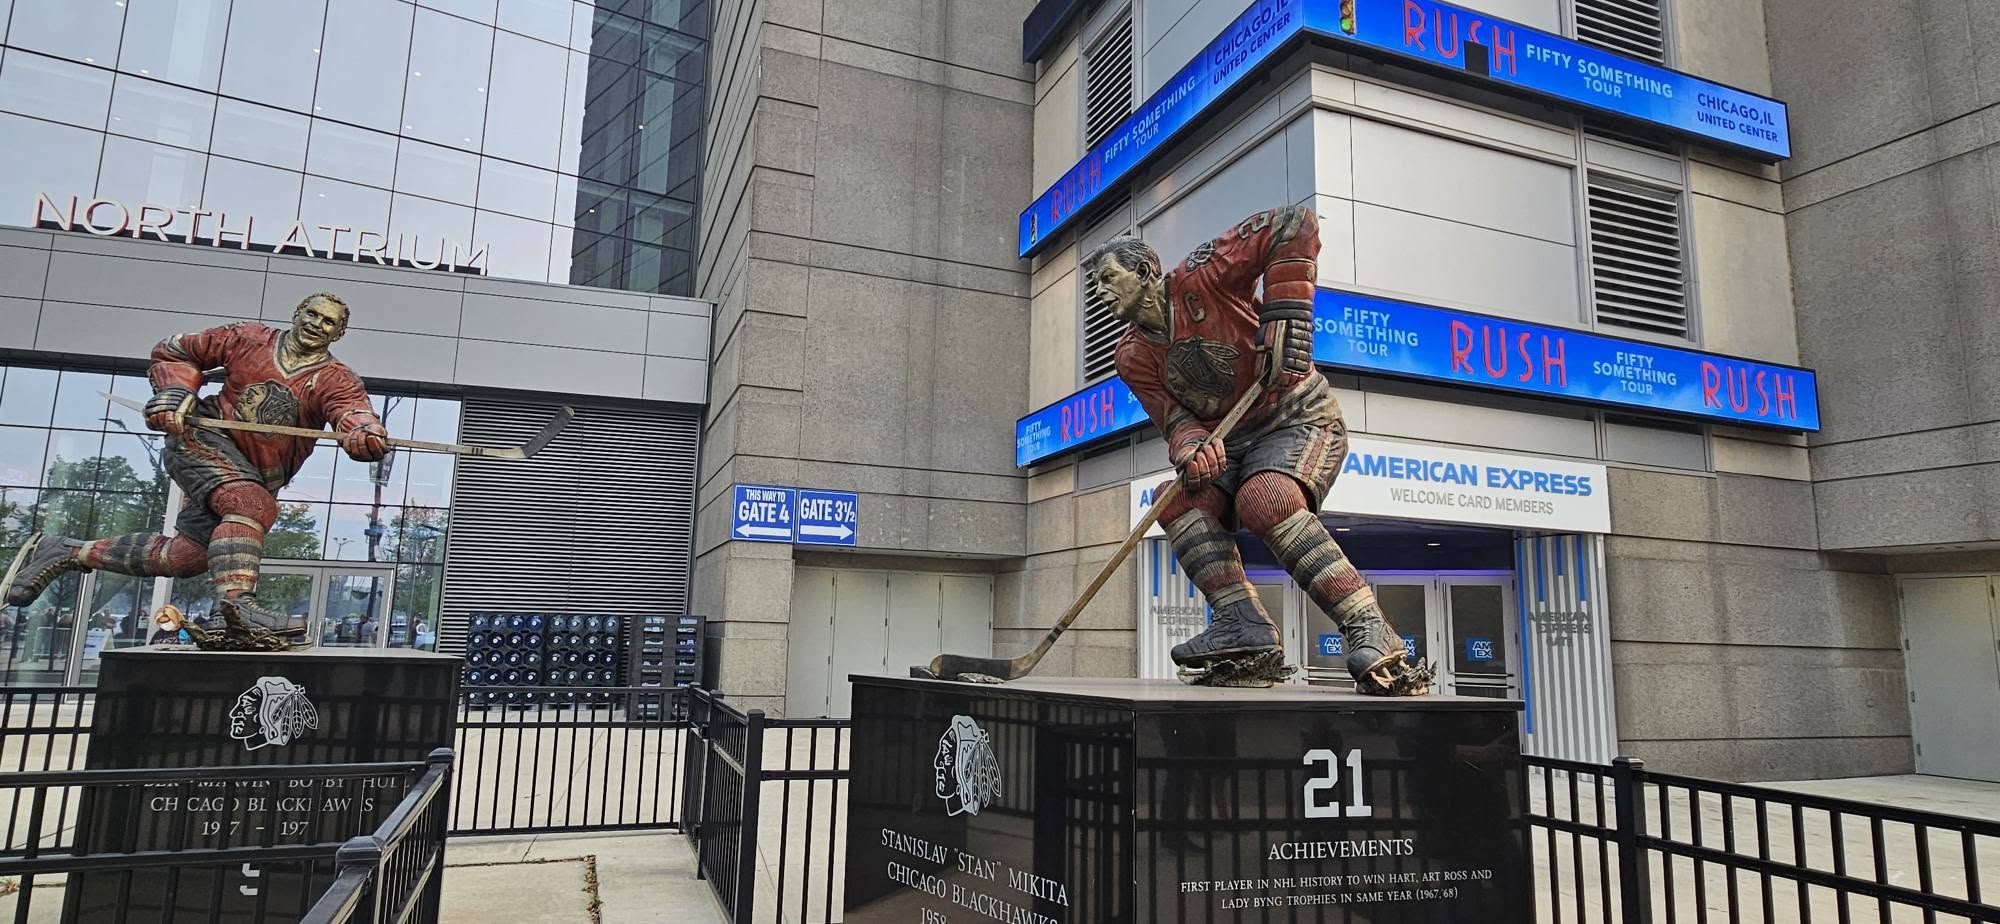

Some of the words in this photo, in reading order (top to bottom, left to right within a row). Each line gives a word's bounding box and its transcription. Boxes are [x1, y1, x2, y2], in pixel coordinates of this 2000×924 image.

[1213, 50, 1247, 85] UNITED
[1250, 12, 1290, 54] CENTER
[1526, 43, 1571, 68] FIFTY
[1577, 58, 1673, 98] SOMETHING
[1584, 76, 1622, 98] TOUR
[1104, 132, 1129, 164] FIFTY
[1132, 75, 1196, 140] SOMETHING
[1697, 93, 1775, 126] CHICAGO,IL
[1135, 122, 1159, 150] TOUR
[1697, 111, 1736, 130] UNITED
[1739, 123, 1778, 142] CENTER
[1051, 155, 1101, 224] RUSH
[32, 191, 253, 250] NORTH
[273, 220, 490, 276] ATRIUM
[1344, 306, 1390, 327] FIFTY
[1314, 317, 1419, 347] SOMETHING
[1347, 339, 1388, 357] TOUR
[1450, 319, 1567, 388] RUSH
[1615, 351, 1655, 369] FIFTY
[1592, 361, 1677, 386] SOMETHING
[1620, 380, 1653, 395] TOUR
[1701, 360, 1797, 420] RUSH
[1060, 384, 1115, 443] RUSH
[1017, 426, 1051, 448] SOMETHING
[1026, 419, 1042, 435] FIFTY
[1342, 452, 1478, 486] AMERICAN
[1486, 466, 1593, 497] EXPRESS
[746, 489, 761, 501] THIS
[1390, 487, 1455, 506] WELCOME
[1458, 493, 1492, 509] CARD
[1495, 498, 1553, 515] MEMBERS
[739, 501, 776, 523] GATE
[779, 504, 789, 523] 4
[800, 498, 833, 520] GATE
[1150, 605, 1204, 616] AMERICAN
[1158, 616, 1205, 626] EXPRESS
[1529, 611, 1591, 622] AMERICAN
[1324, 637, 1342, 646] AM
[1326, 645, 1342, 653] EX
[1473, 641, 1491, 650] AM
[1475, 649, 1492, 658] EX
[288, 778, 344, 788] BOBY
[1303, 748, 1372, 818] 21
[150, 796, 240, 812] CHCAG
[247, 796, 374, 812] BLCKAWS
[201, 821, 241, 836] 197
[280, 821, 309, 836] 197
[1267, 838, 1414, 860] ACHIEVEMENTS
[881, 827, 948, 865] STANISLAV
[954, 847, 1002, 882] "STAN"
[1008, 867, 1069, 907] MIKITA
[1181, 881, 1211, 892] FIRST
[1214, 879, 1254, 891] PLAYER
[1257, 878, 1270, 889] IN
[1274, 877, 1296, 889] NHL
[1300, 875, 1343, 888] HISTORY
[1347, 874, 1360, 886] TO
[1363, 873, 1385, 885] WIN
[1422, 871, 1441, 882] ART
[1444, 870, 1467, 881] ROSS
[1470, 869, 1492, 880] AND
[887, 861, 947, 899] CHICAGO
[952, 883, 1058, 924] BLACKHAWK
[1221, 898, 1250, 909] LADY
[1254, 896, 1282, 908] BYNG
[1286, 893, 1337, 907] TROPHIES
[1341, 893, 1352, 904] IN
[1356, 891, 1384, 903] SAME
[1387, 890, 1413, 901] YEAR
